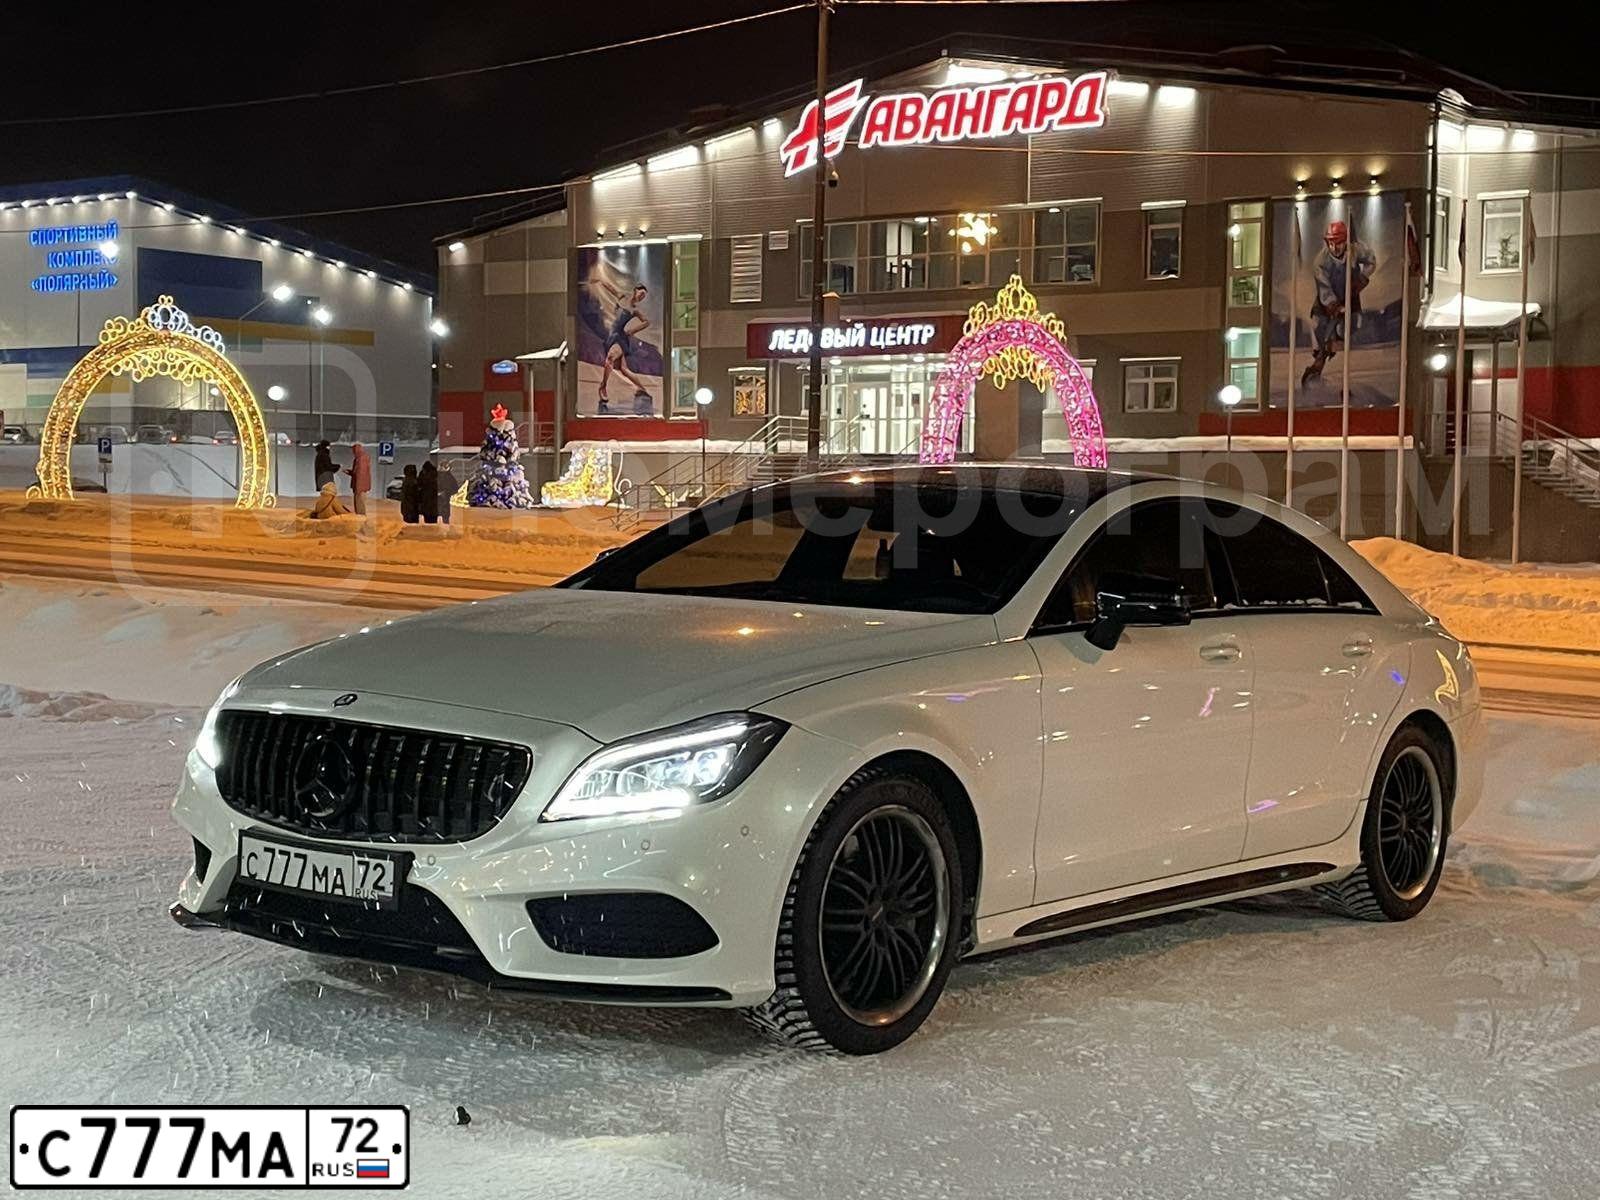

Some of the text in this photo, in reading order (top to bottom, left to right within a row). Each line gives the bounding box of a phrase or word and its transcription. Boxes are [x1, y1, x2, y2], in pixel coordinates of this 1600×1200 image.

[859, 72, 1107, 148] АВАНГАРД
[30, 220, 117, 246] СПОРТИВНЫЙ
[31, 269, 118, 292] «ПОЛЯРНЫЙ»
[768, 322, 936, 353] ЛЕДВЫЙ ЦЕНТР
[246, 847, 386, 897] С777МА 72
